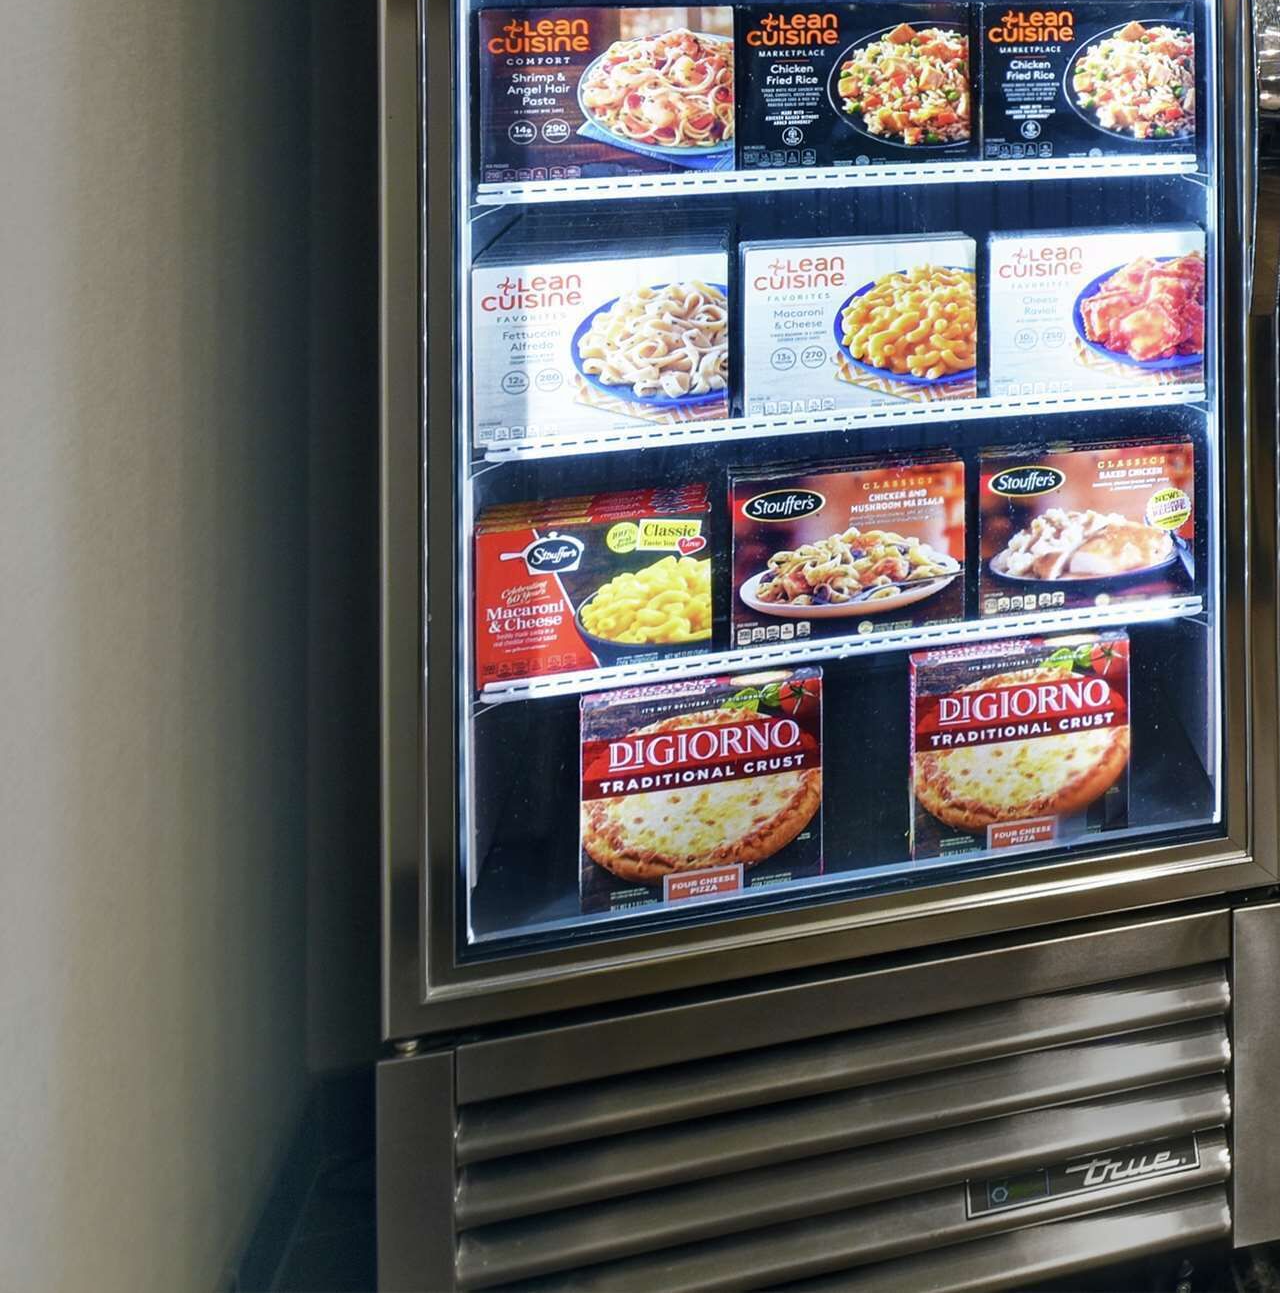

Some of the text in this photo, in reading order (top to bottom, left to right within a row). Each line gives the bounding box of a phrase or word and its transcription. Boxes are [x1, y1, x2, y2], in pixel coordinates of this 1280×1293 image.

[780, 13, 837, 29] Lean
[1019, 11, 1073, 27] Lean
[524, 18, 589, 35] Lean
[506, 57, 571, 66] COMFORT
[1010, 61, 1051, 69] Chicken
[771, 65, 814, 74] Chicken
[512, 73, 566, 84] Shrimp &
[767, 75, 818, 85] Fried Rice
[1007, 71, 1055, 81] Fried Rice
[507, 84, 570, 96] Angel Hair
[523, 97, 556, 106] Pasta
[546, 125, 566, 133] 290
[1030, 246, 1082, 261] Lean
[787, 256, 844, 273] Lean
[517, 274, 582, 292] Lean
[768, 293, 830, 302] FAVORITES
[1022, 296, 1058, 304] Cheese
[774, 308, 824, 319] Macaroni
[1024, 306, 1057, 315] Ravioli
[775, 319, 823, 329] & Cheese
[502, 330, 561, 341] Fettuccini
[511, 342, 554, 352] Alfredo
[805, 351, 823, 359] 270
[1098, 456, 1166, 469] CLASSICS
[1100, 467, 1163, 479] BAKED CHICKEN
[862, 477, 933, 490] CLASSICS
[998, 472, 1055, 491] Stouffer's
[869, 489, 927, 502] CHICKEN AND
[753, 495, 815, 515] Stouffer's
[851, 496, 944, 513] MUSHROOM MARSALA
[644, 522, 696, 537] Classic
[530, 546, 578, 565] Stouffer's
[487, 600, 564, 621] Macaroni
[488, 613, 562, 634] & Cheese
[931, 712, 1115, 746] TRADITIONAL CRUST
[600, 754, 805, 794] TRADITIONAL CRUST
[994, 825, 1051, 842] FOUR CHEESE
[1011, 834, 1035, 844] PIZZA
[672, 874, 736, 891] FOUR CHEESE
[690, 884, 718, 895] PIZZA
